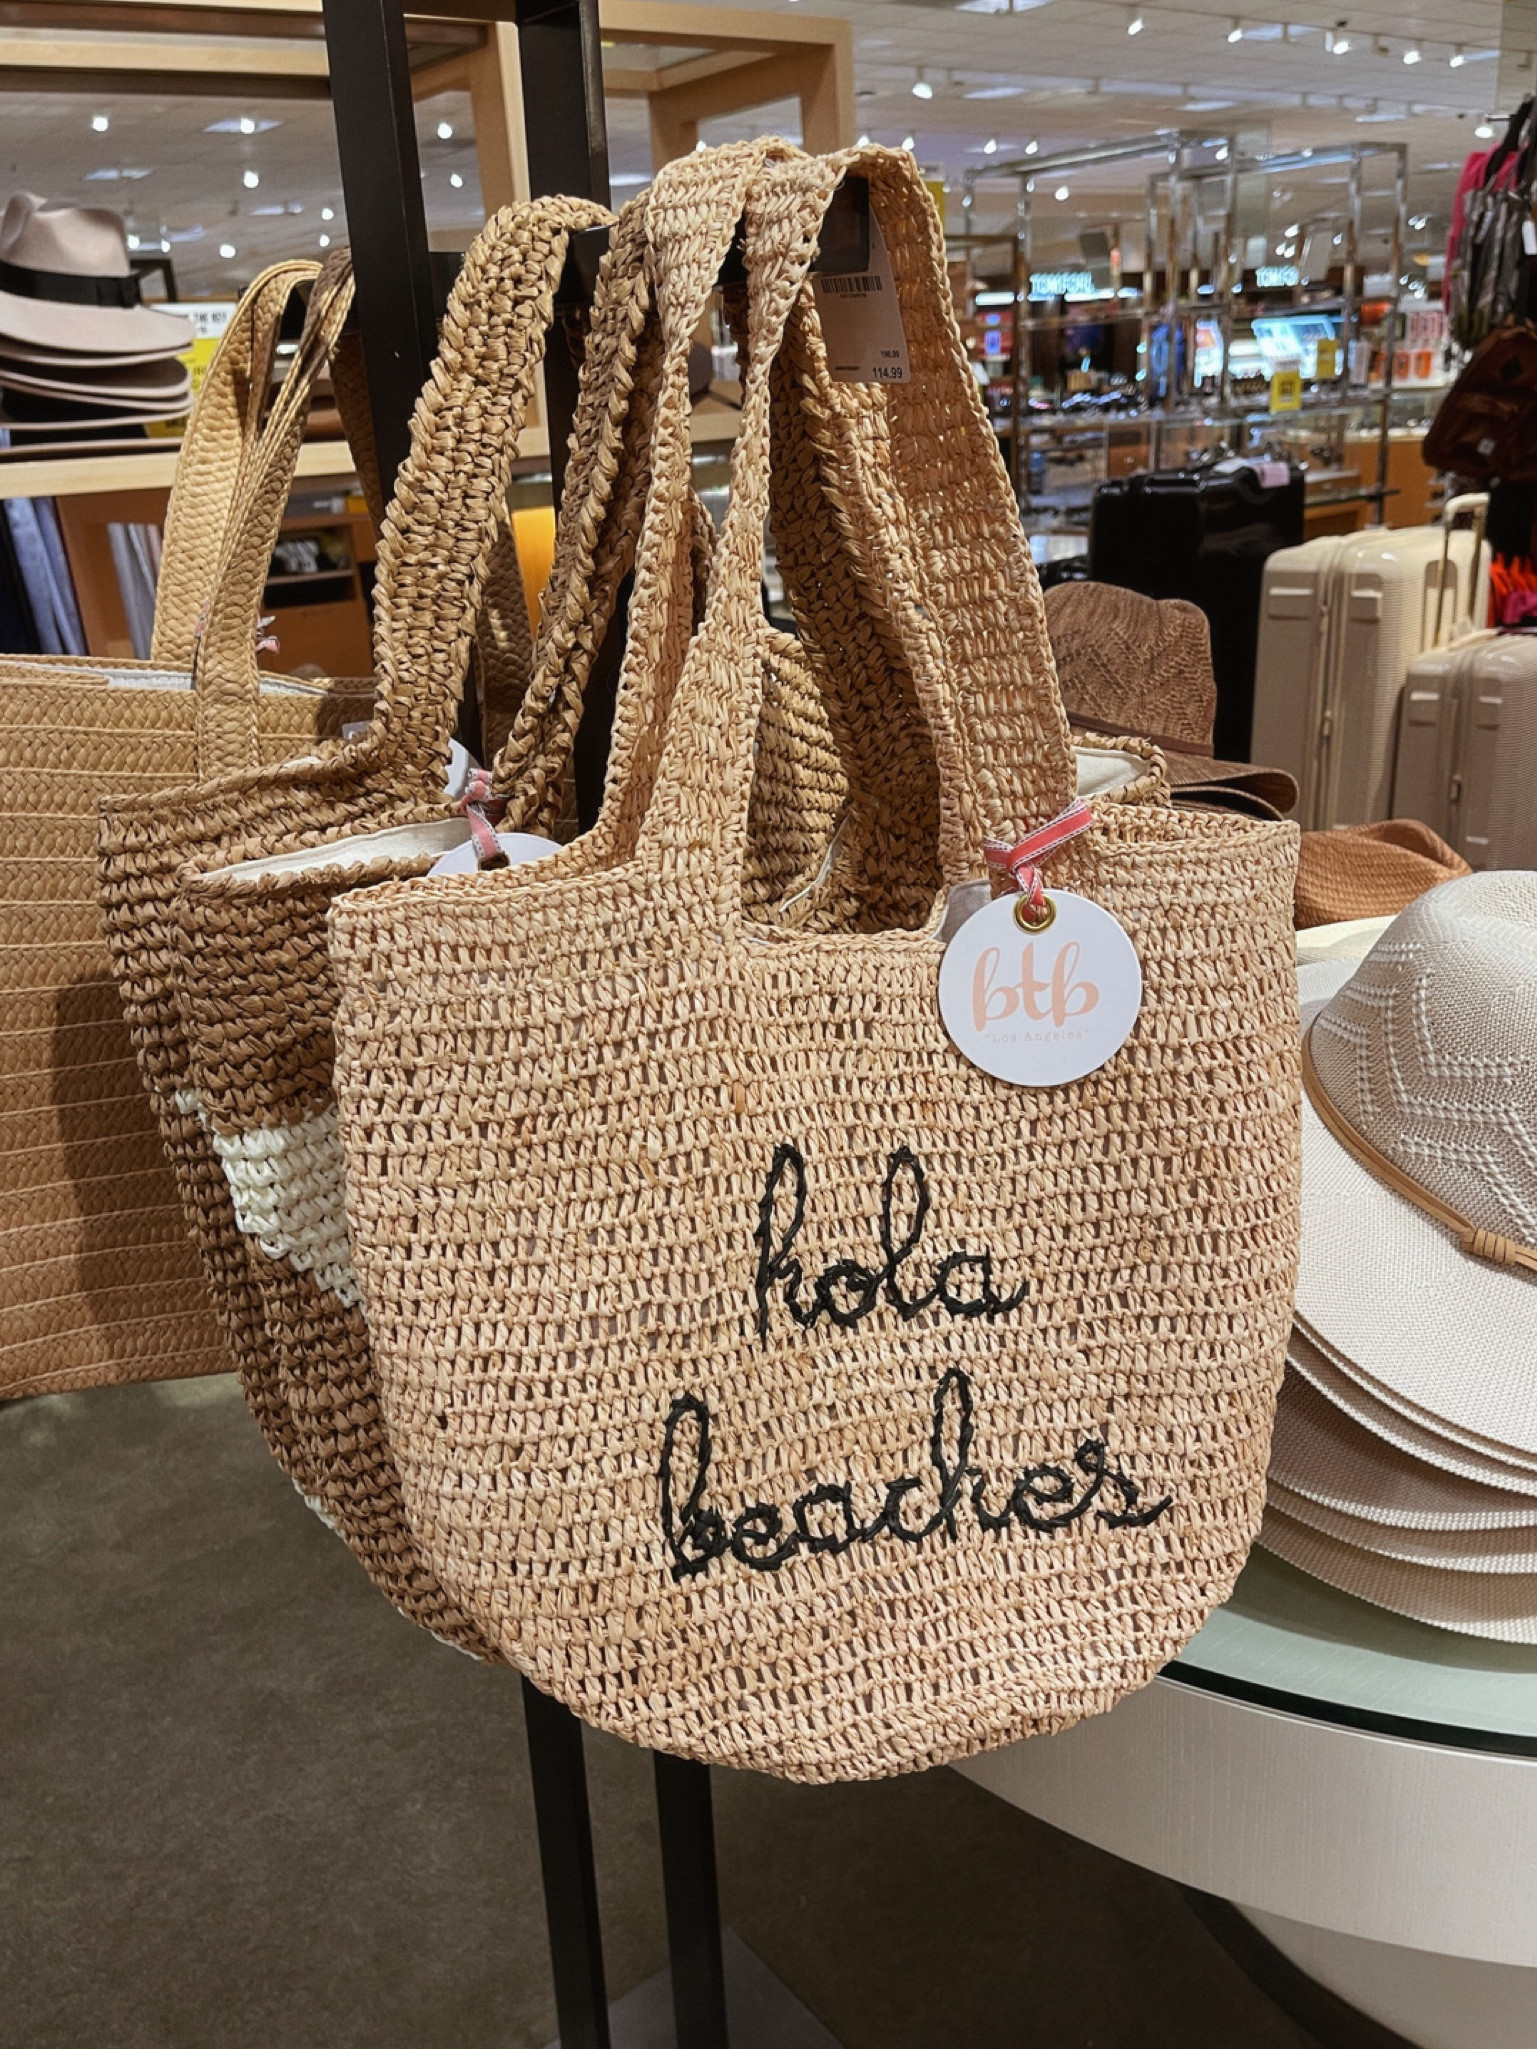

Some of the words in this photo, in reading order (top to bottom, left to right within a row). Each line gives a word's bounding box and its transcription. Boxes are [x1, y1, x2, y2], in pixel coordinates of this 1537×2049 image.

[873, 366, 903, 379] 114.99
[972, 941, 1100, 1032] btb
[756, 1143, 1030, 1348] hola
[659, 1368, 1174, 1583] beaches
